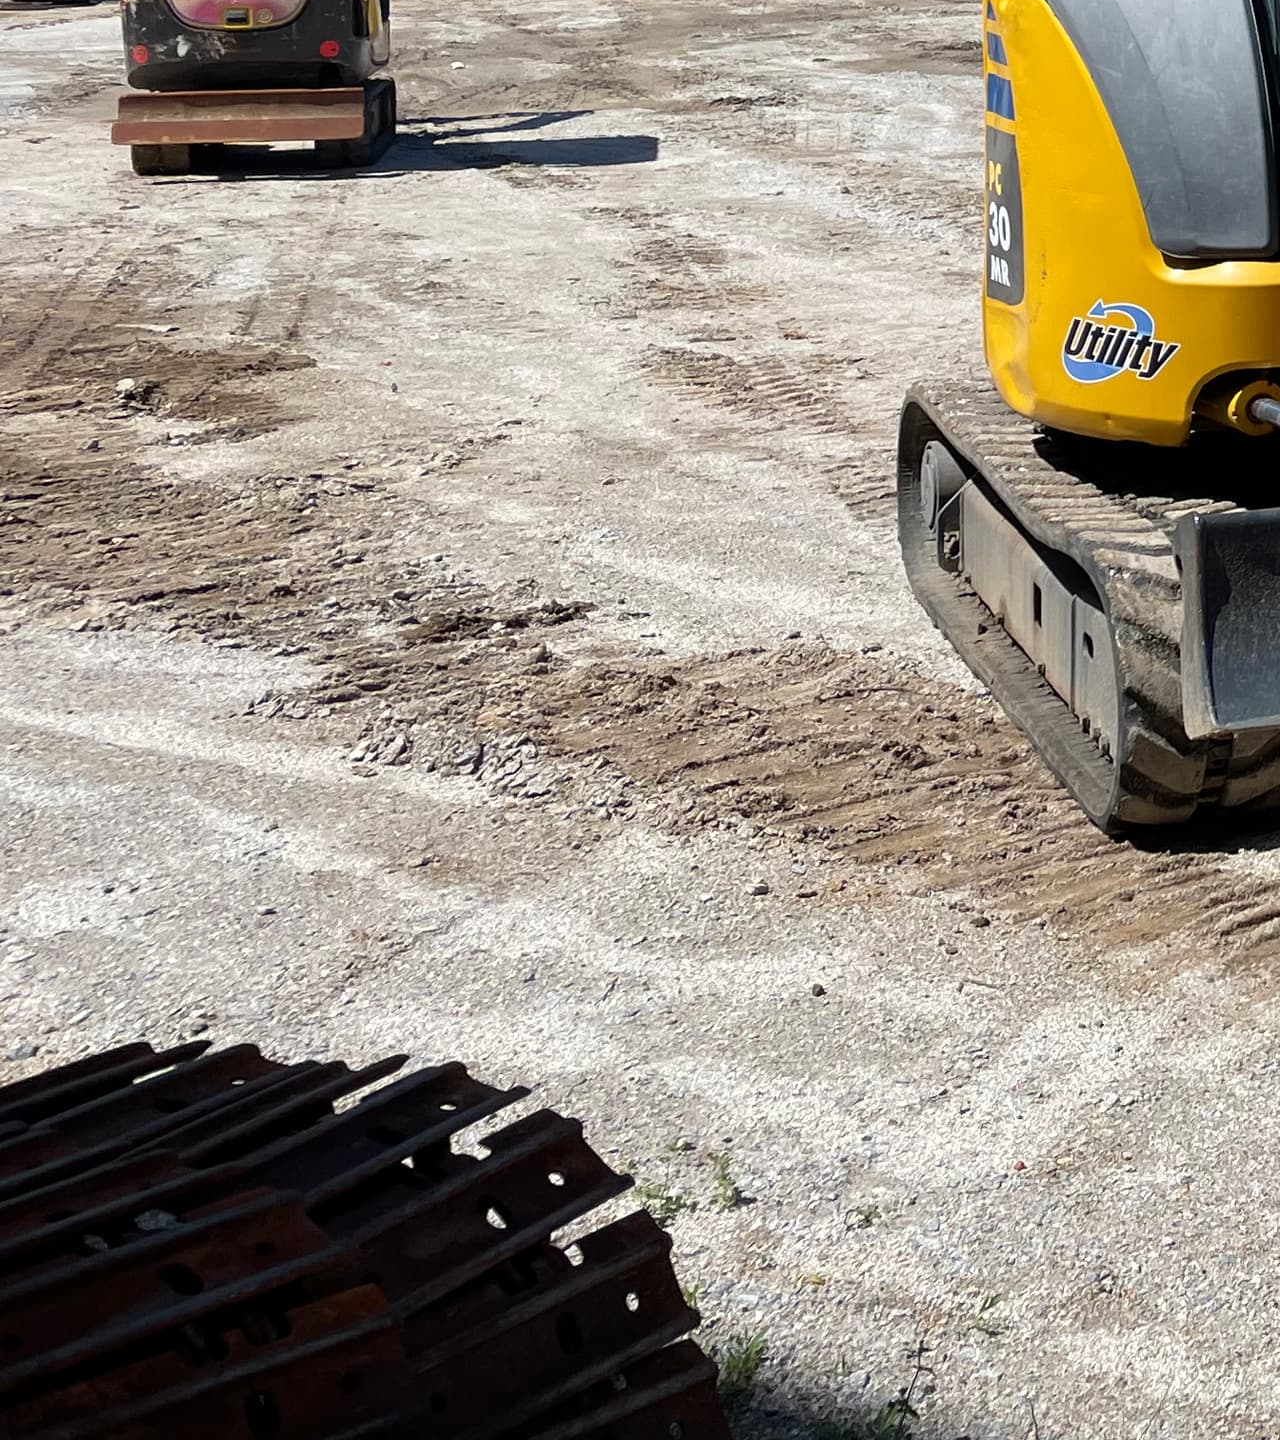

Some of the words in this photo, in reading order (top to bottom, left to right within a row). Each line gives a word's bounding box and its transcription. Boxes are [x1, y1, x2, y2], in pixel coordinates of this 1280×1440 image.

[988, 160, 1002, 196] PC
[989, 201, 1012, 252] 30
[989, 254, 1012, 288] MR
[1064, 318, 1179, 379] Utility
